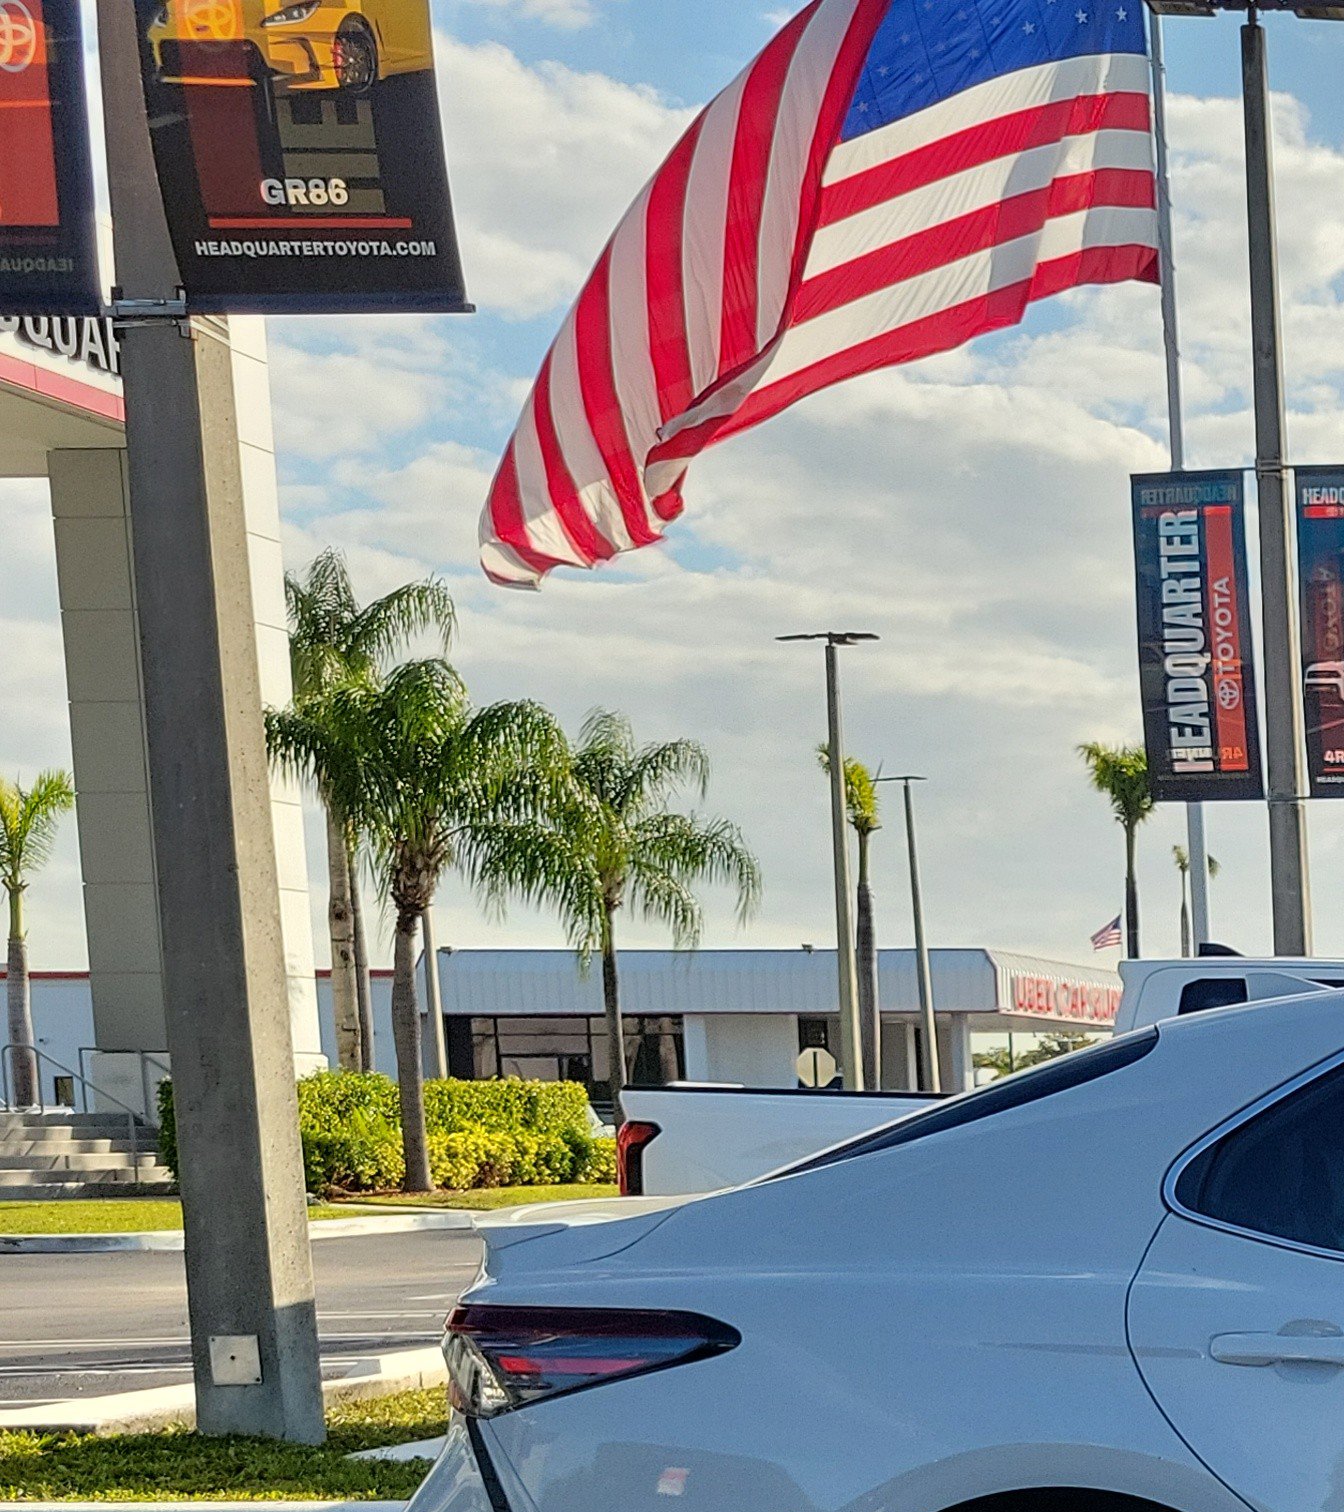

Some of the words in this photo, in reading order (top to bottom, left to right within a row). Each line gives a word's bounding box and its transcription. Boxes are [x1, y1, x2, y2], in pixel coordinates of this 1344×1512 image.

[259, 178, 349, 205] GR86
[195, 241, 436, 257] HEADQUARTERTOYOTA.COM
[1158, 507, 1214, 773] HEADQUARTER
[1213, 577, 1235, 675] TOYOTA
